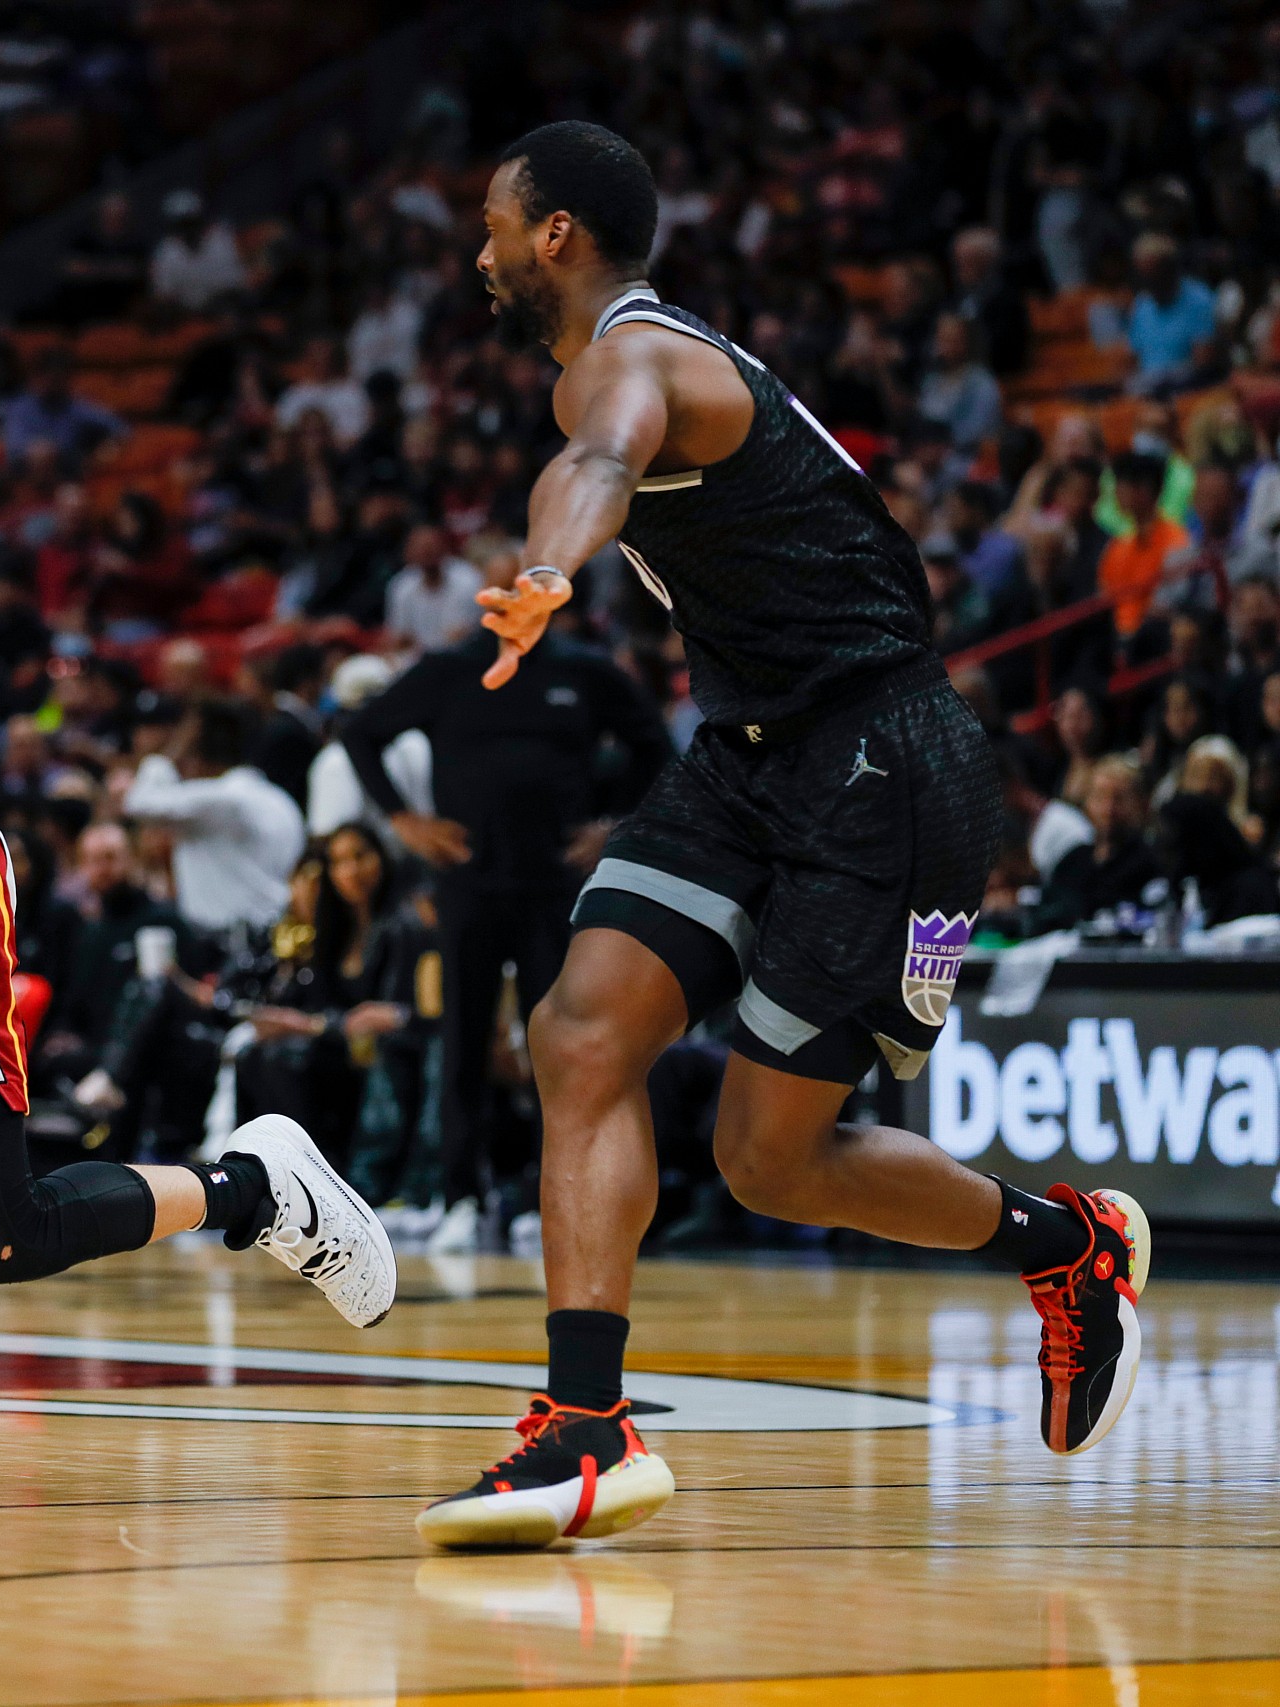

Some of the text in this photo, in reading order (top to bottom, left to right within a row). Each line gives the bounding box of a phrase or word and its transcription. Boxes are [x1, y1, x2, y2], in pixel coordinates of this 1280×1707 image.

[915, 942, 966, 955] SACRAM
[907, 956, 962, 981] KIN
[929, 1005, 1280, 1207] betwa
